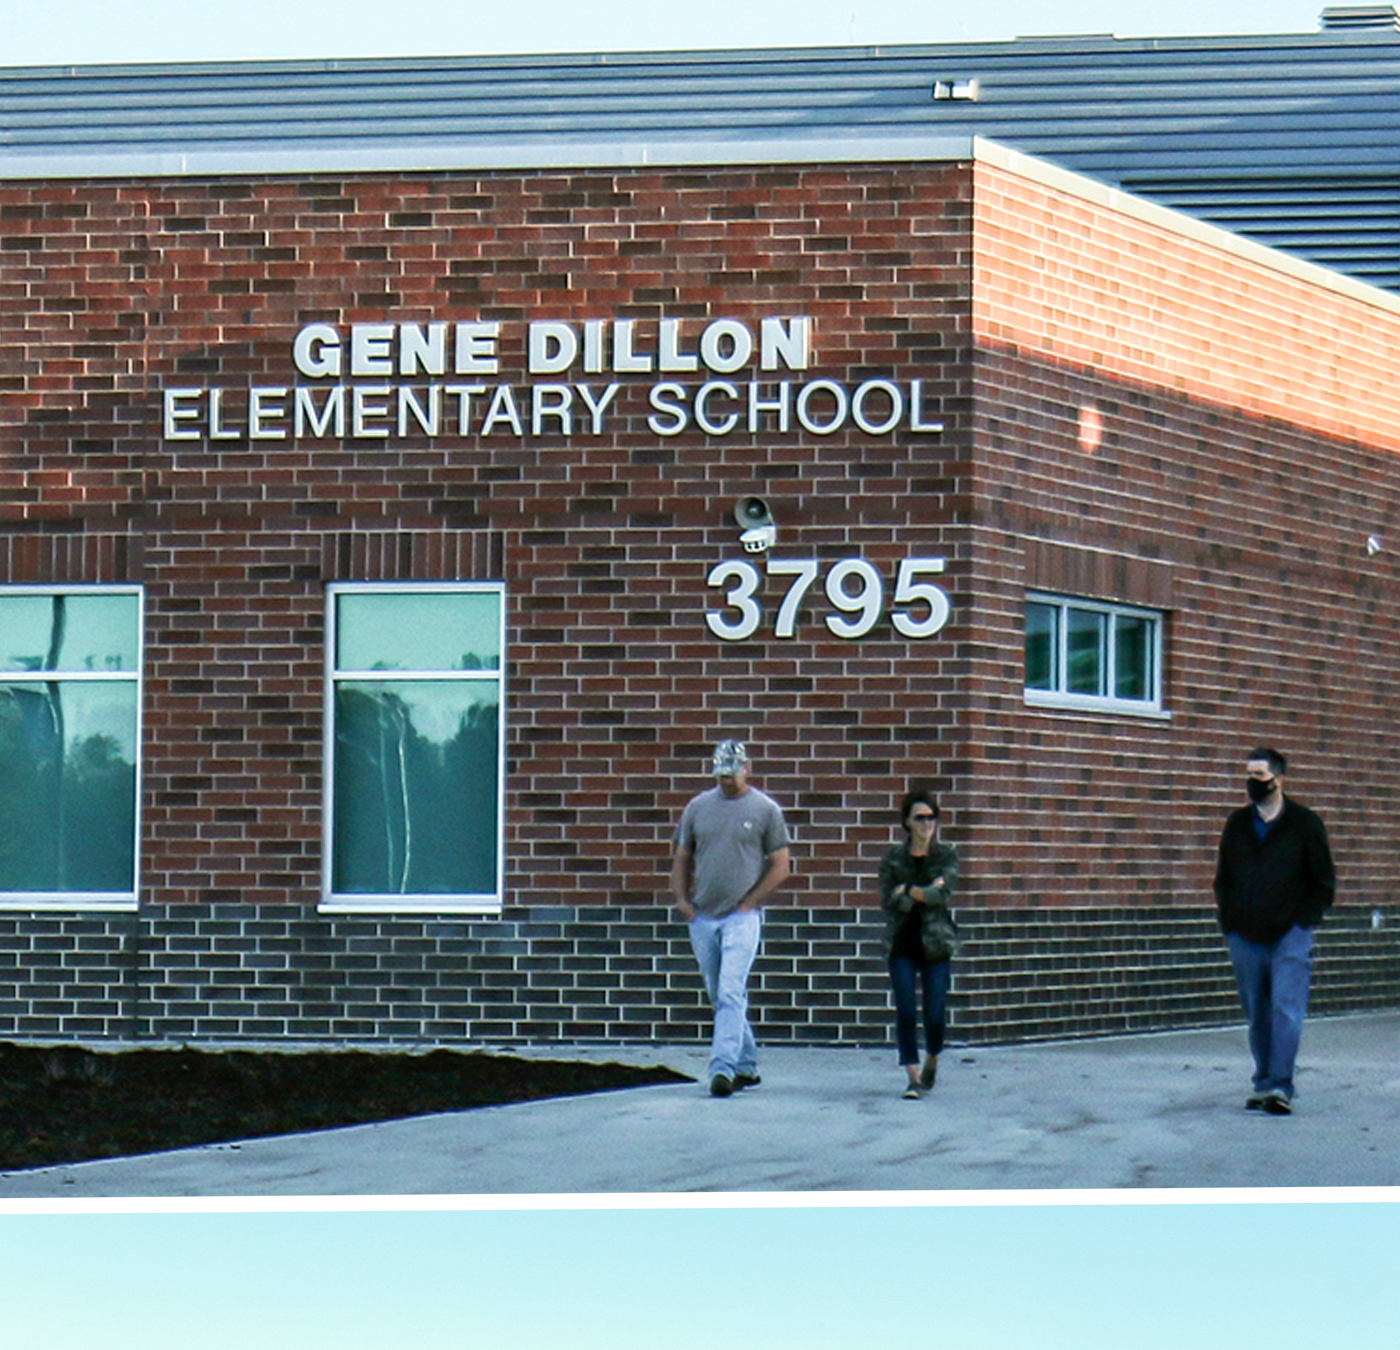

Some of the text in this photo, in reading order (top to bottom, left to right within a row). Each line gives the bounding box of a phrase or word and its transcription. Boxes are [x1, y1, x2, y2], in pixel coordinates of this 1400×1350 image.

[293, 316, 810, 377] GENE DILLON
[163, 380, 944, 440] ELEMENTARY SCHOOL
[705, 557, 952, 640] 3795
